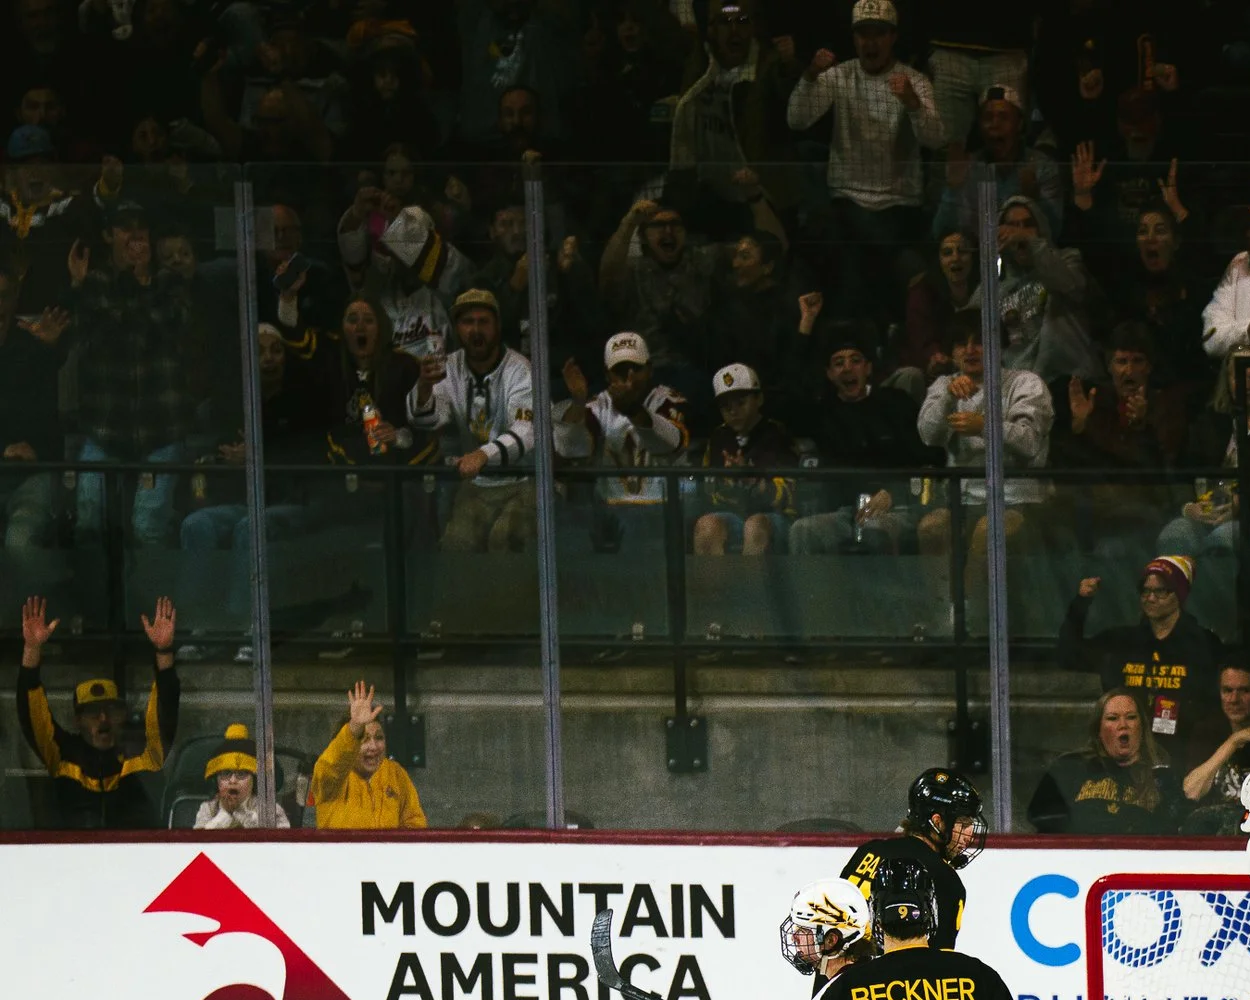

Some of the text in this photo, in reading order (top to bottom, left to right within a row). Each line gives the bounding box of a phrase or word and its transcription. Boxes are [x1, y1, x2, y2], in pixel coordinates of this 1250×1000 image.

[515, 407, 534, 421] AS
[1146, 676, 1182, 689] DVILS
[855, 852, 881, 880] BA
[361, 881, 737, 939] MOUNTAIN
[897, 905, 908, 919] 9
